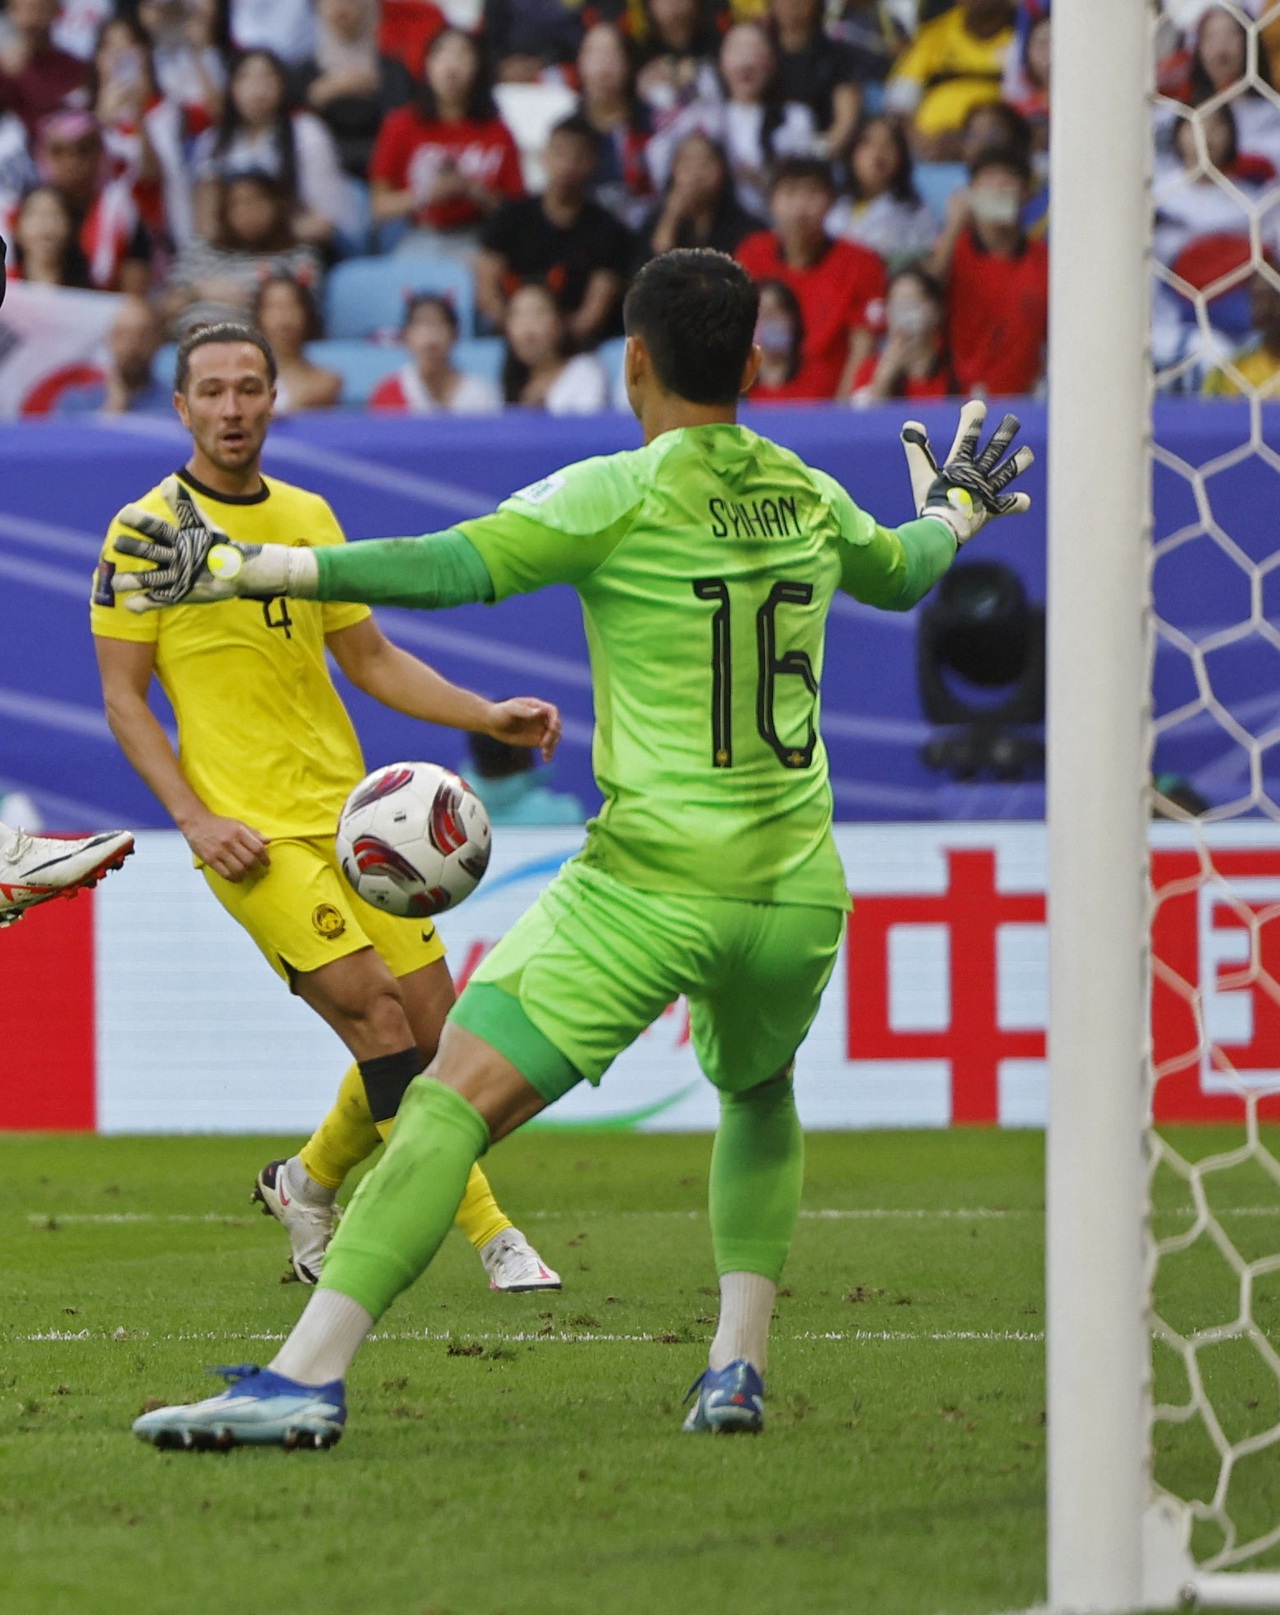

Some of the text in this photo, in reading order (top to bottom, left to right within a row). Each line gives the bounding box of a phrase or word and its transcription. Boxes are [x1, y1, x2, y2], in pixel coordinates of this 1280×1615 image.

[709, 495, 802, 538] SYIHAN
[262, 596, 293, 640] 4
[693, 578, 818, 768] 16
